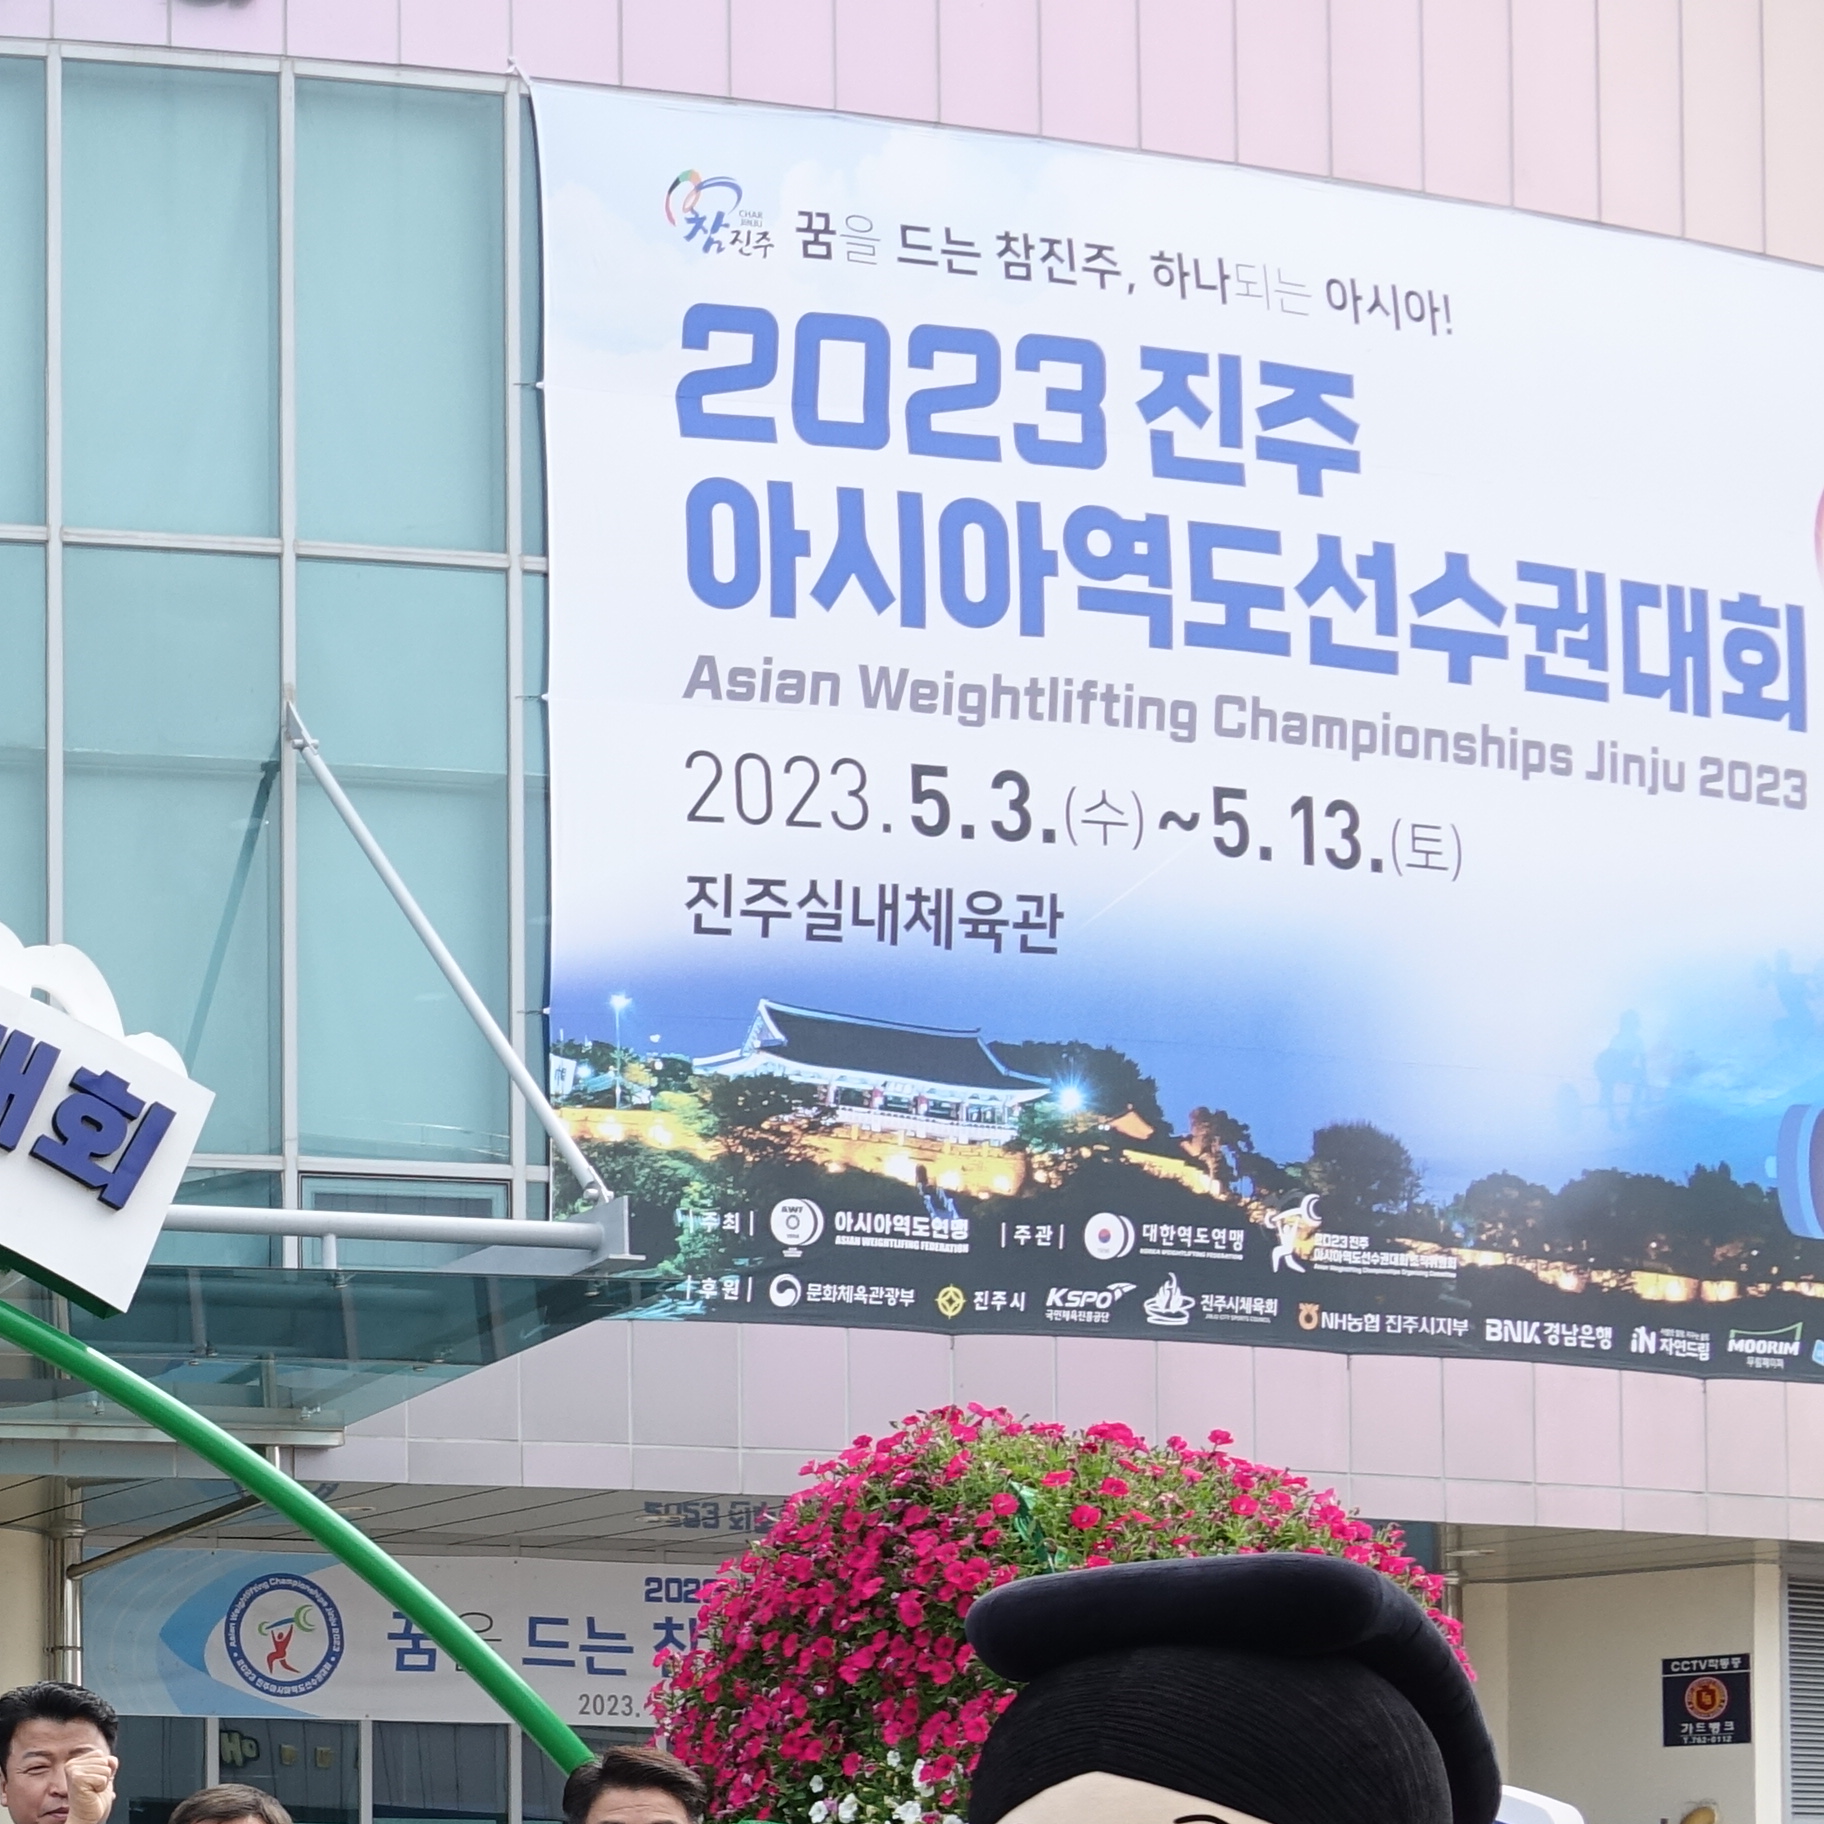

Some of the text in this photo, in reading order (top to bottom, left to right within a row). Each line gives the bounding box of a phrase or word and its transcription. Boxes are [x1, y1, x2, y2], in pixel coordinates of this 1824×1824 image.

[795, 211, 1455, 336] 꿈을 드는 참진주, 하나되는 아시아!
[675, 302, 1362, 498] 2023 진주
[684, 476, 1809, 735] 아시아역도선수권대회
[683, 652, 1810, 811] Asian Weightlifting Championships Jinju 2023
[683, 873, 1066, 956] 진주실내체육관
[835, 1209, 970, 1241] 아시아역도연맹
[1141, 1222, 1245, 1251] 대한역도연맹
[806, 1282, 916, 1307] 문화체육관광부
[973, 1290, 1026, 1312] 진주시
[1046, 1286, 1113, 1310] KSPO
[1200, 1294, 1279, 1317] 진주시체육회
[1320, 1314, 1470, 1339] NH농협 진주시지부
[1543, 1321, 1613, 1350] 경남은행
[1659, 1336, 1711, 1362] 자연드림
[1728, 1337, 1800, 1356] MOORIM
[522, 1616, 634, 1677] 드는
[578, 1693, 641, 1718] 2023.
